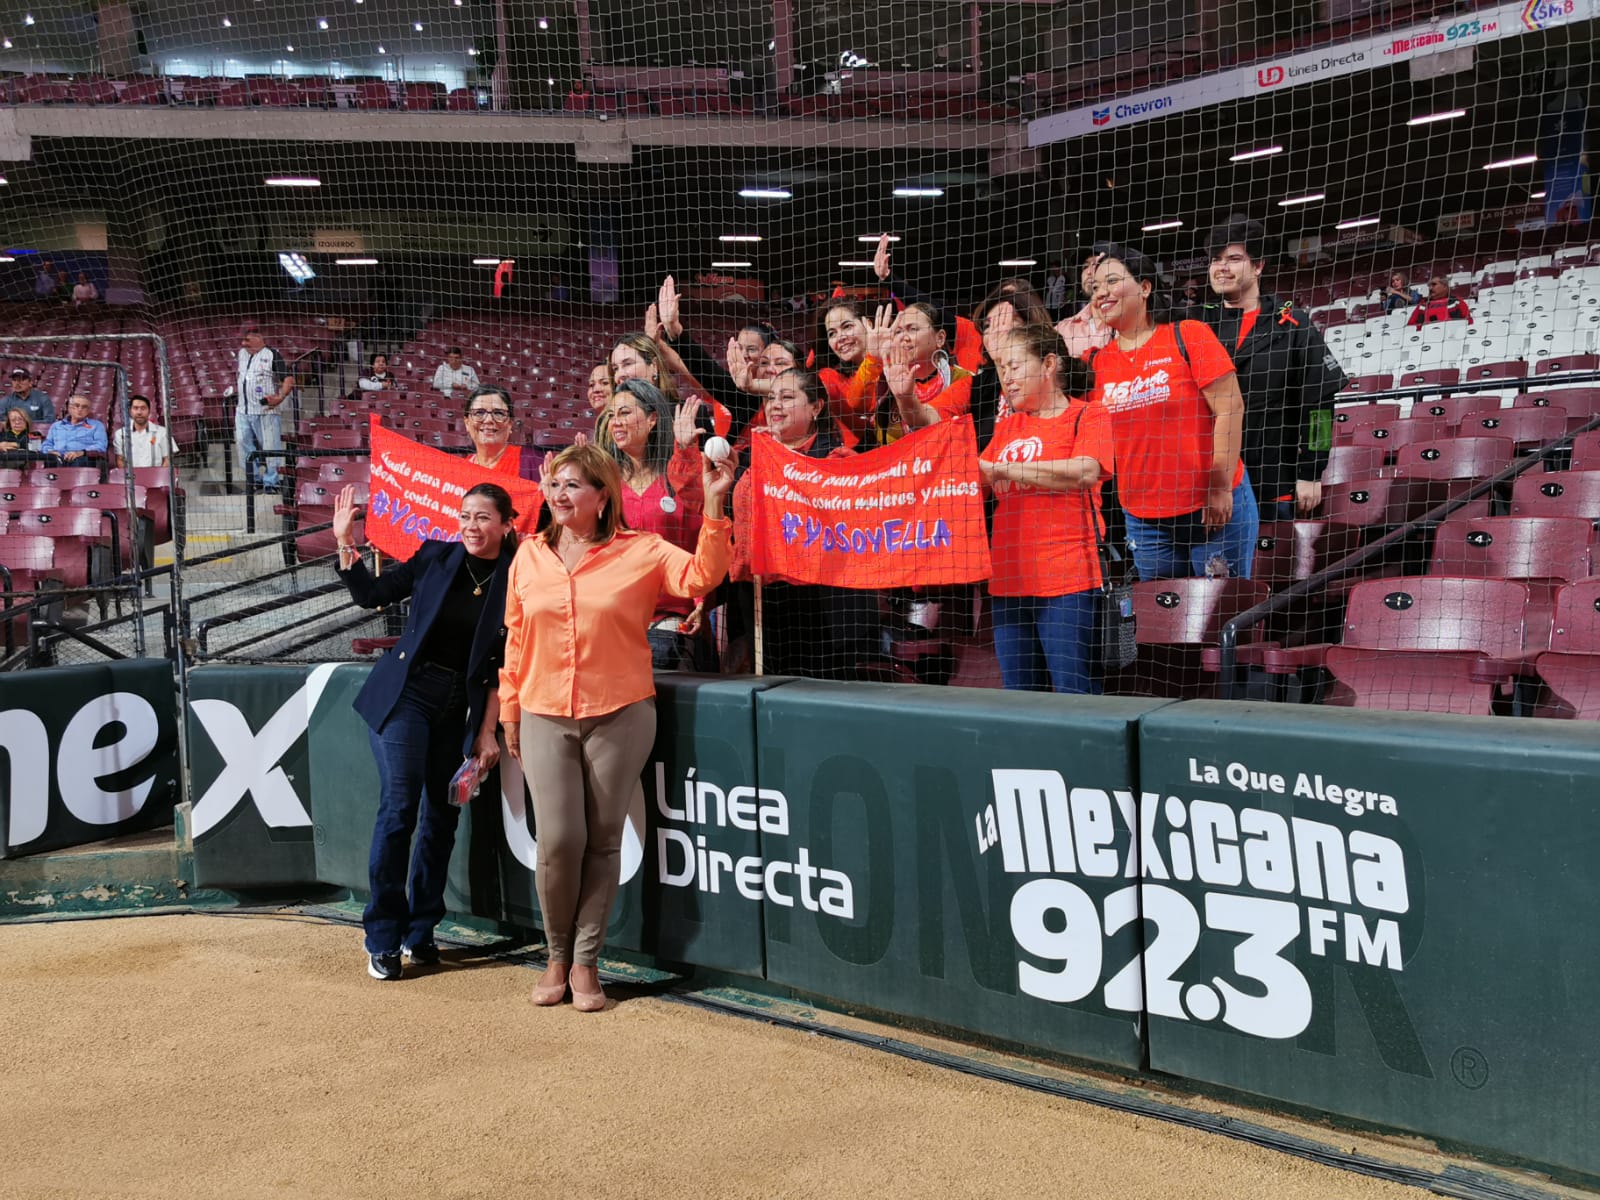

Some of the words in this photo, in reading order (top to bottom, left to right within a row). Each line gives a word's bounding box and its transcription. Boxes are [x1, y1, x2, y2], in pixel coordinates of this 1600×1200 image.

[1392, 33, 1445, 55] Mexicana
[1446, 21, 1481, 41] 92.3
[1482, 22, 1497, 33] FM
[1321, 51, 1365, 70] Directa
[1115, 94, 1172, 119] Chevron
[412, 471, 441, 489] para
[822, 475, 859, 488] para
[913, 457, 932, 475] la
[404, 489, 440, 512] contra
[812, 495, 851, 511] contra
[855, 491, 916, 511] mujeres
[655, 762, 790, 836] Línea
[1188, 757, 1220, 785] La
[1226, 763, 1286, 794] Que
[1293, 773, 1399, 818] Alegra
[975, 802, 998, 855] La
[991, 768, 1410, 914] Mexicana
[657, 827, 855, 920] Directa
[1009, 878, 1313, 1040] 92.3
[1307, 906, 1403, 972] FM
